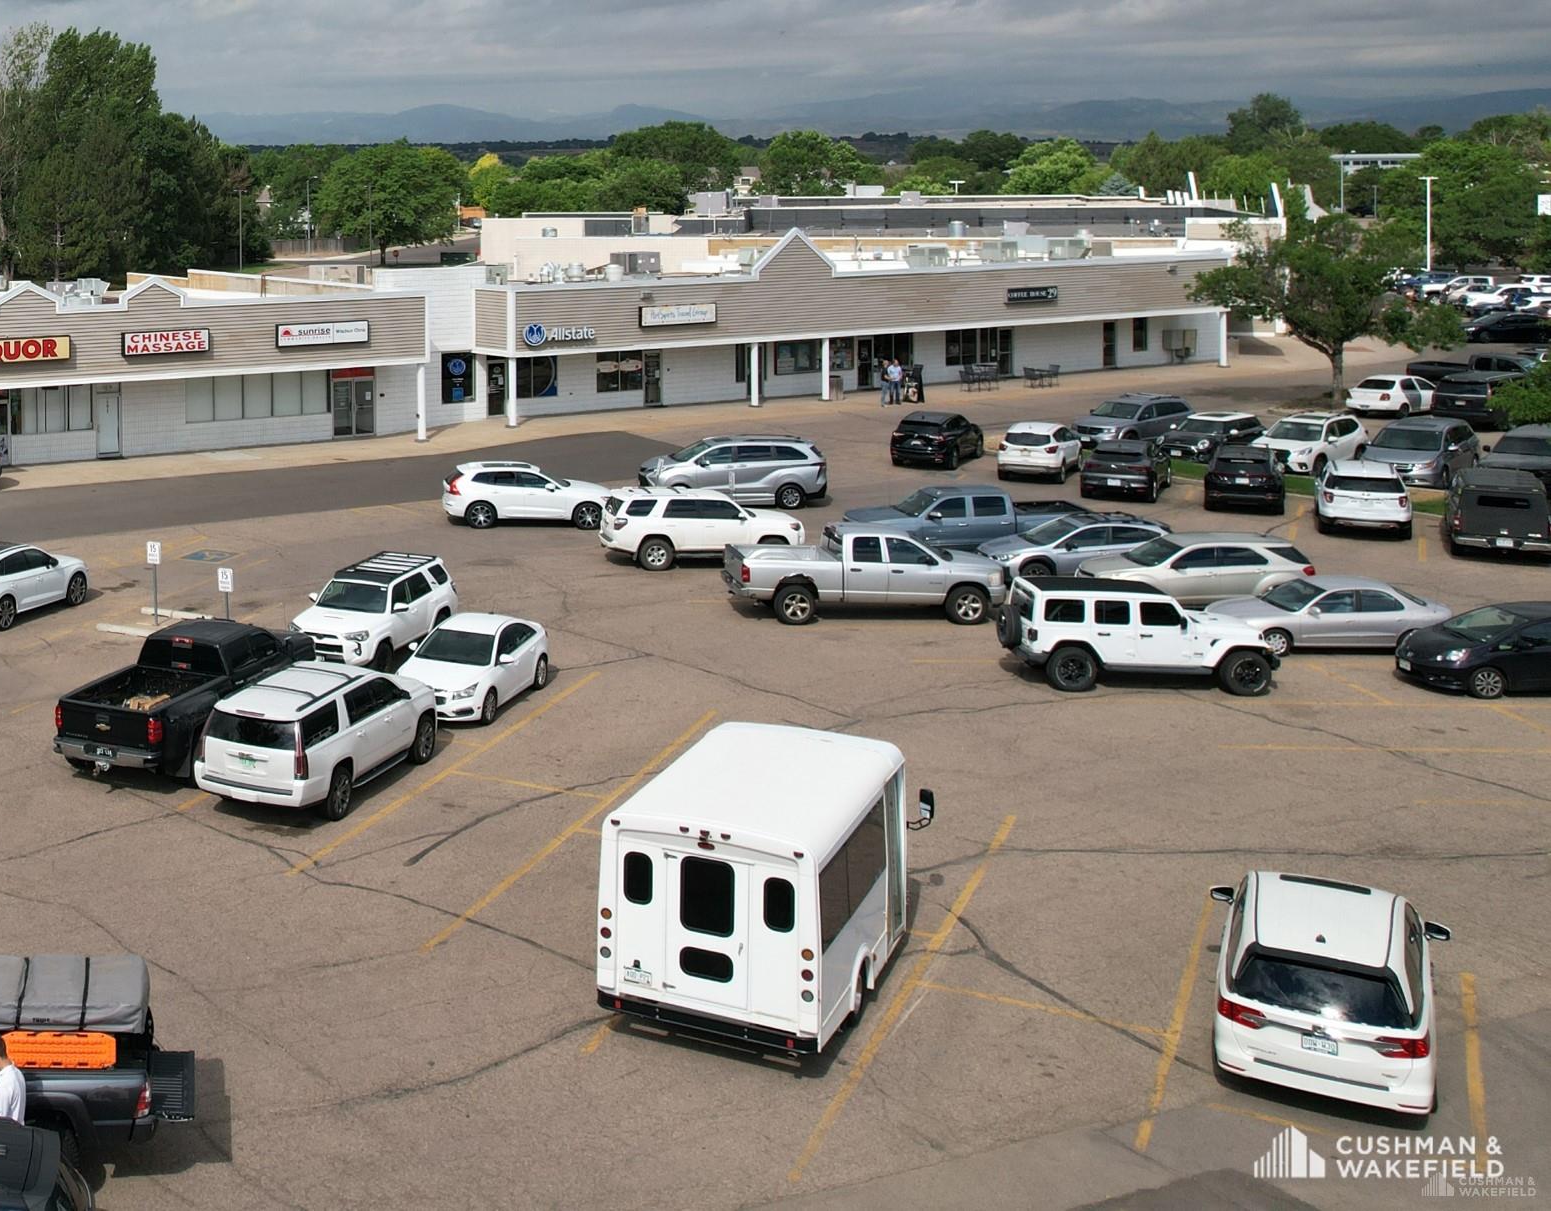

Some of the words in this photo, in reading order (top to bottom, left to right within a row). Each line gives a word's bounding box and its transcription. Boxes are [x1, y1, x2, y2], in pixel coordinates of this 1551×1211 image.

[298, 327, 331, 336] sunrise
[548, 326, 595, 341] Allstate
[130, 331, 202, 343] CHINESE
[126, 340, 206, 353] MASSAGE
[150, 544, 157, 553] 15
[221, 571, 229, 580] 15
